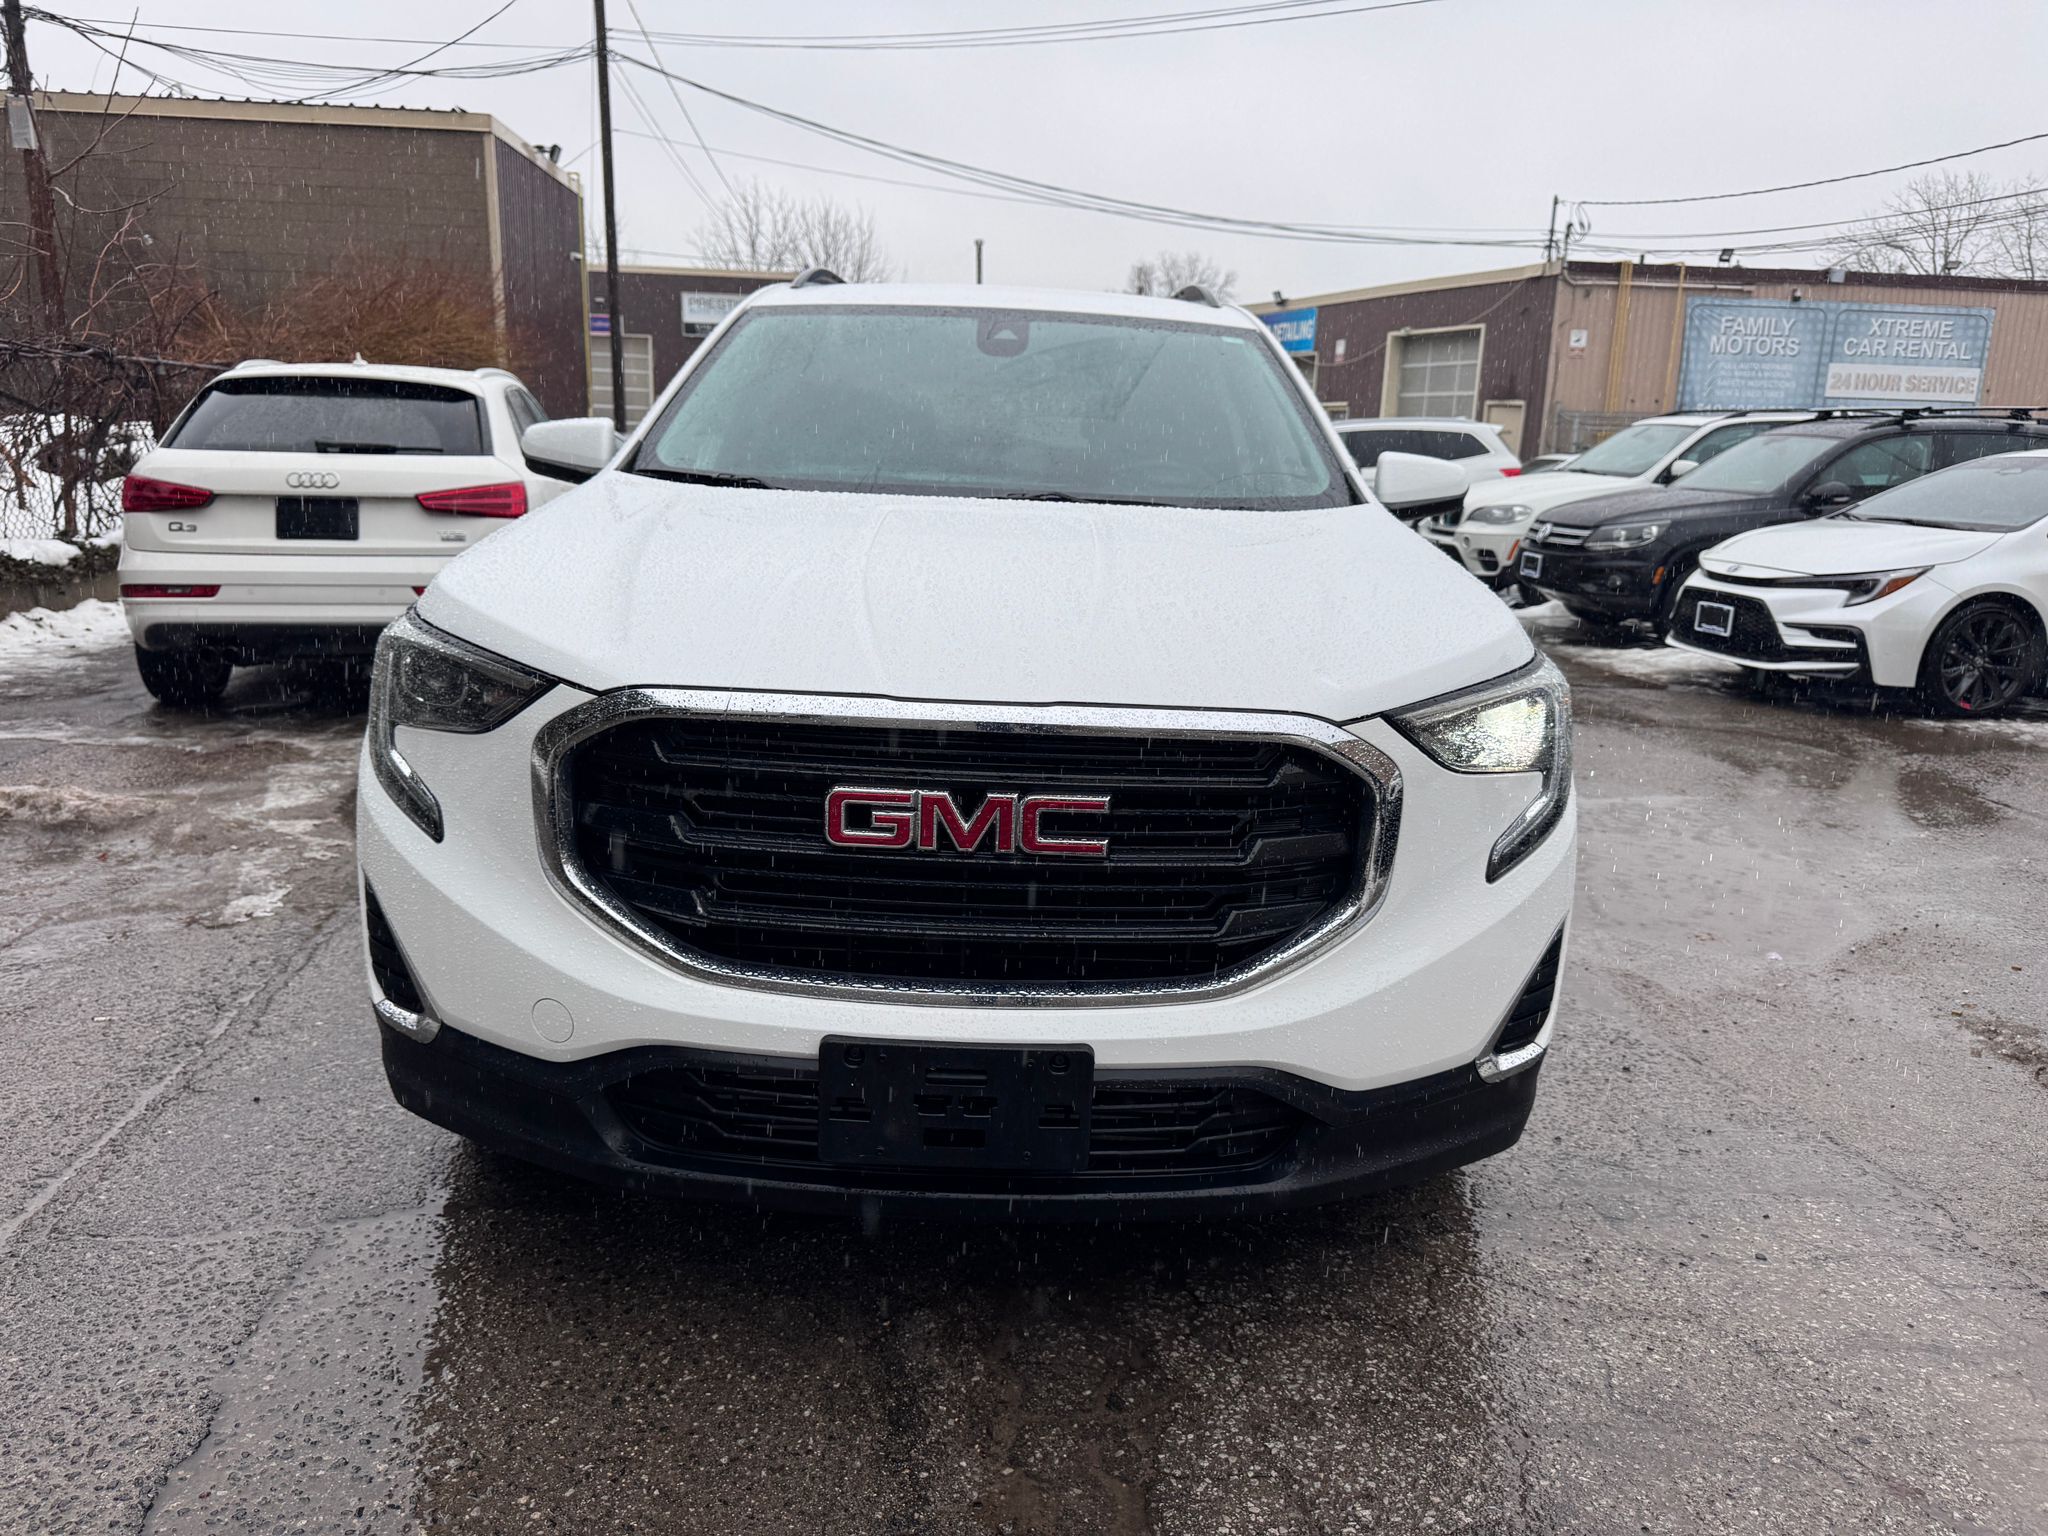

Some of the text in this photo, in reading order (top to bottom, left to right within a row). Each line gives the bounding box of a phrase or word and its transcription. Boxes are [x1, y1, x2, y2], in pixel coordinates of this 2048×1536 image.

[1720, 316, 1796, 336] FAMILY
[1868, 318, 1954, 339] XTREME
[1710, 335, 1801, 356] MOTORS
[1844, 338, 1972, 360] CAR RENTAL
[1829, 372, 1977, 394] 24 HOUR SERVICE
[168, 521, 197, 532] Q3
[825, 786, 1110, 857] GMC
